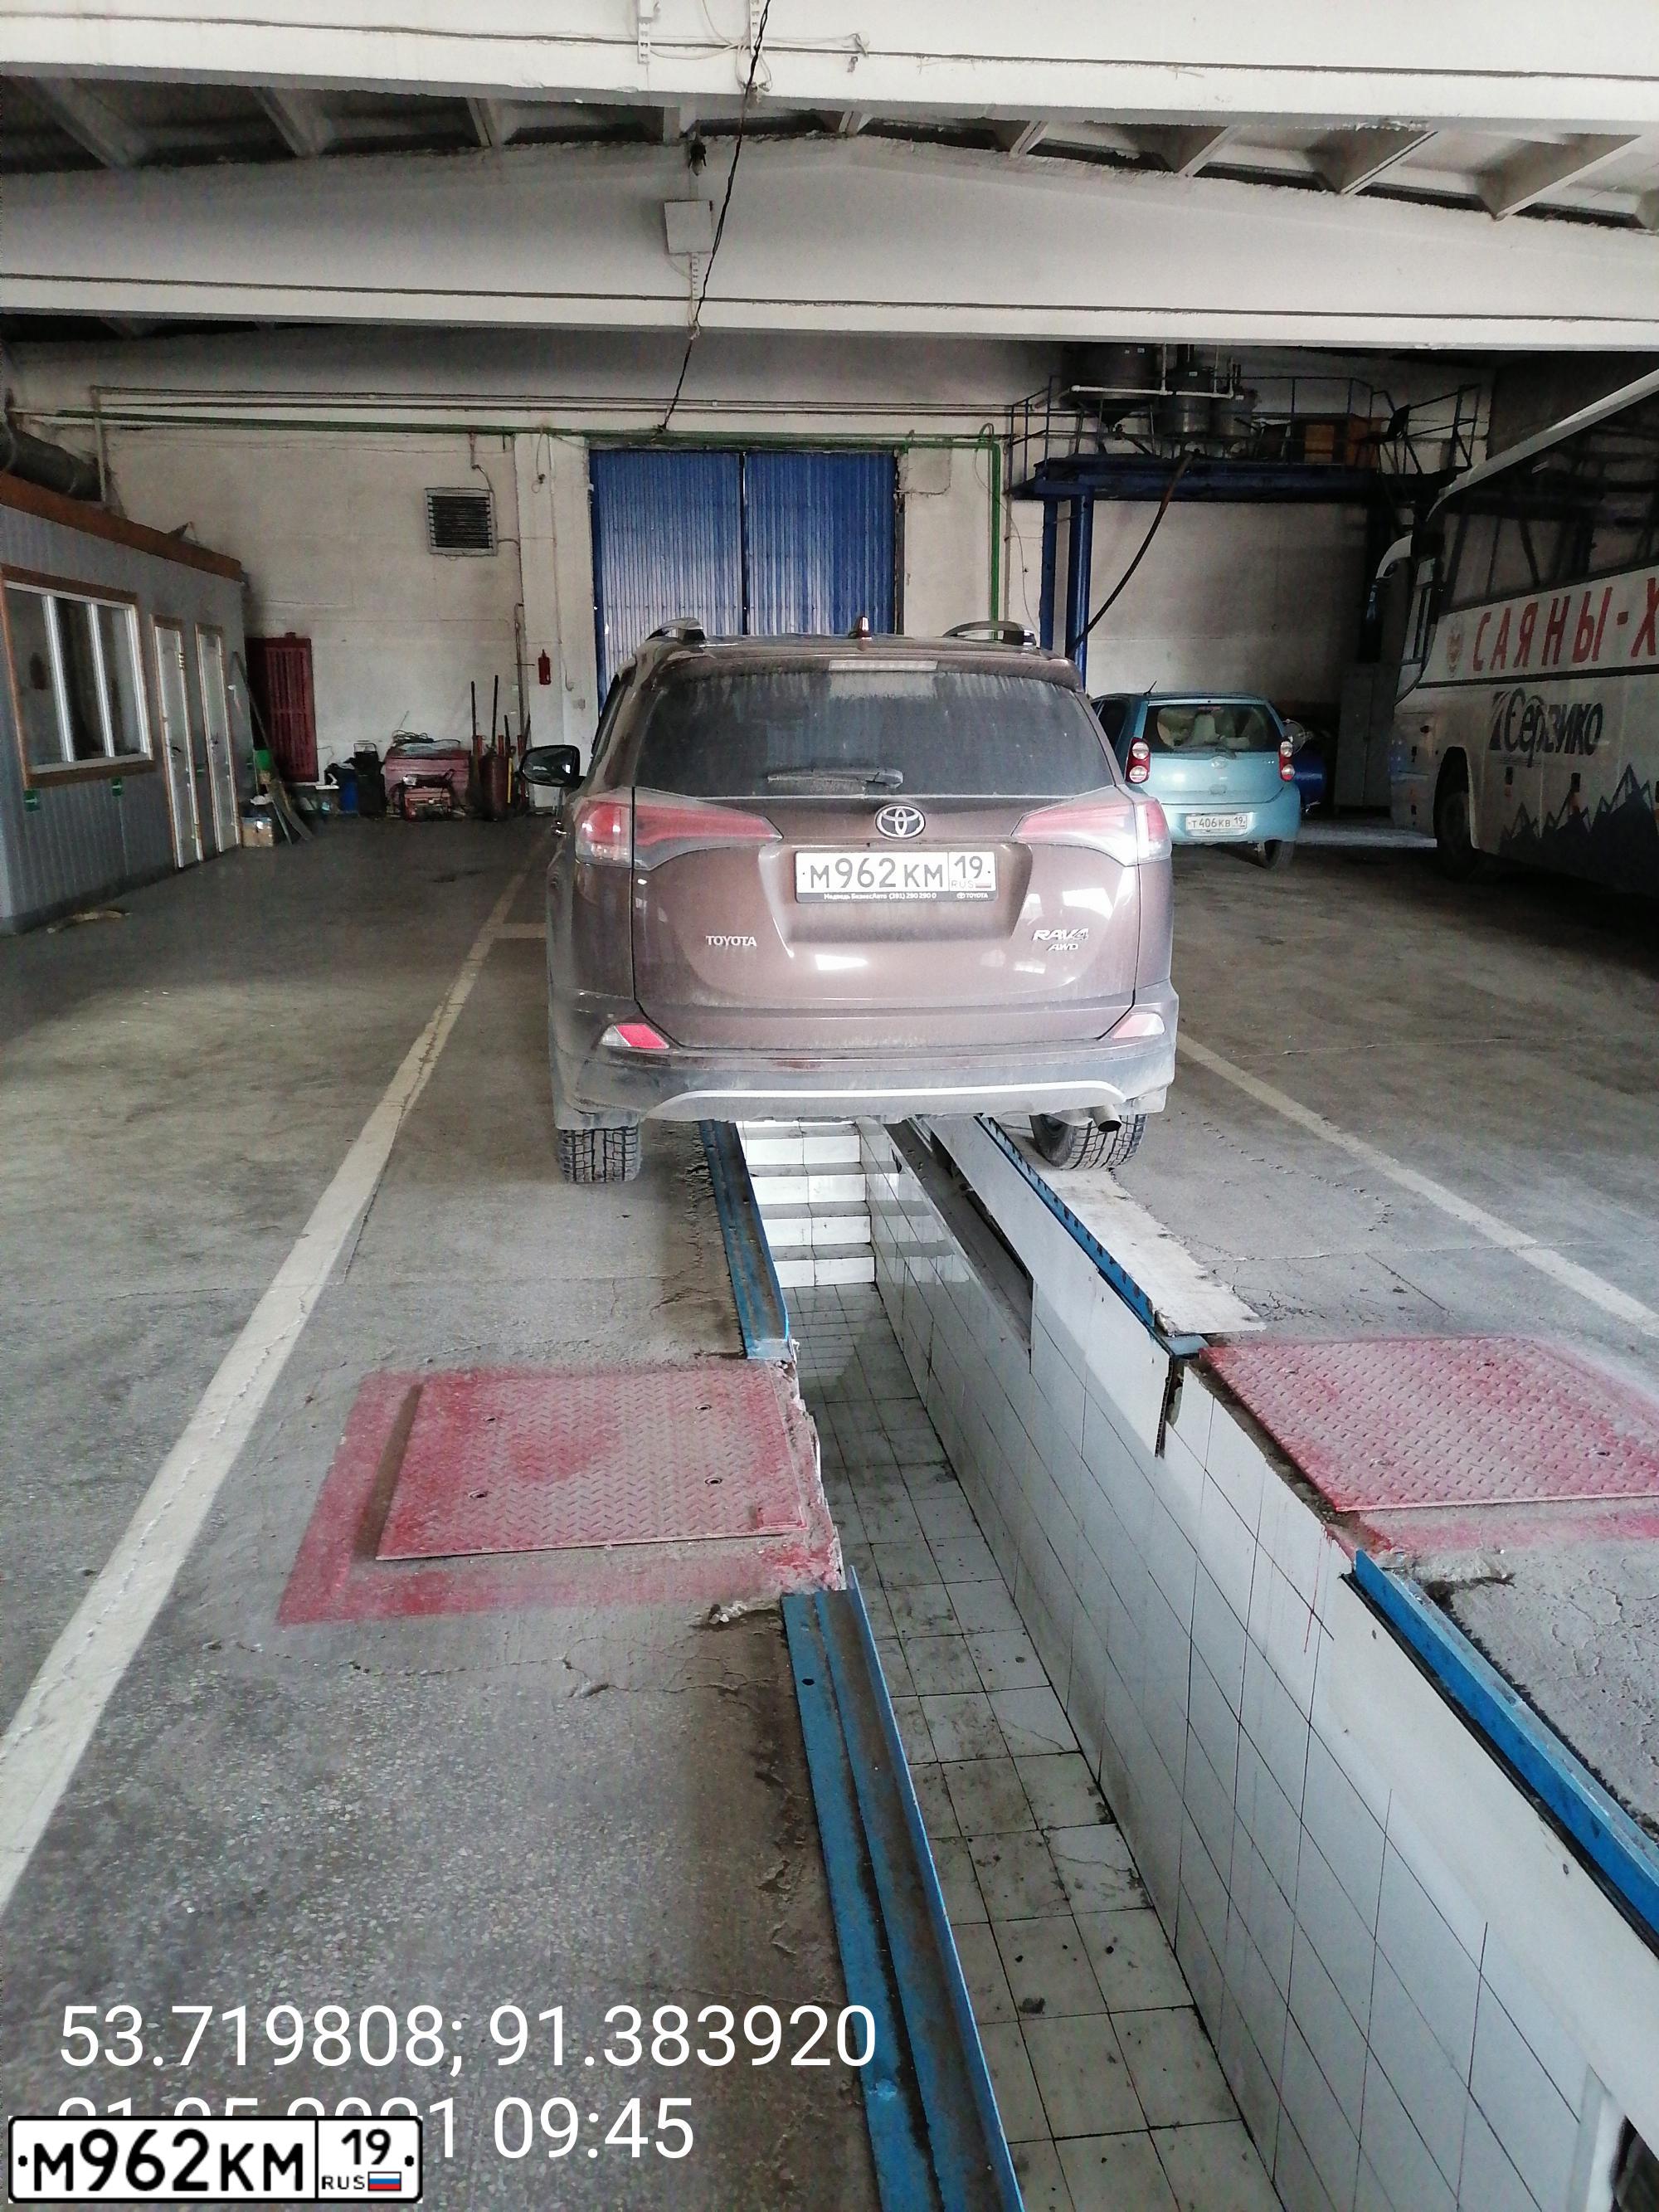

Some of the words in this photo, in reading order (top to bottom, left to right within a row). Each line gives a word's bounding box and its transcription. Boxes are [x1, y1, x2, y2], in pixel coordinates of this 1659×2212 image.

[1191, 818, 1231, 828] Т406КВ
[810, 858, 943, 889] М962КМ
[954, 855, 983, 879] 19
[951, 880, 974, 889] RUS
[1032, 928, 1089, 941] RAV4
[705, 935, 757, 947] TOYOTA
[1047, 943, 1079, 952] AWD
